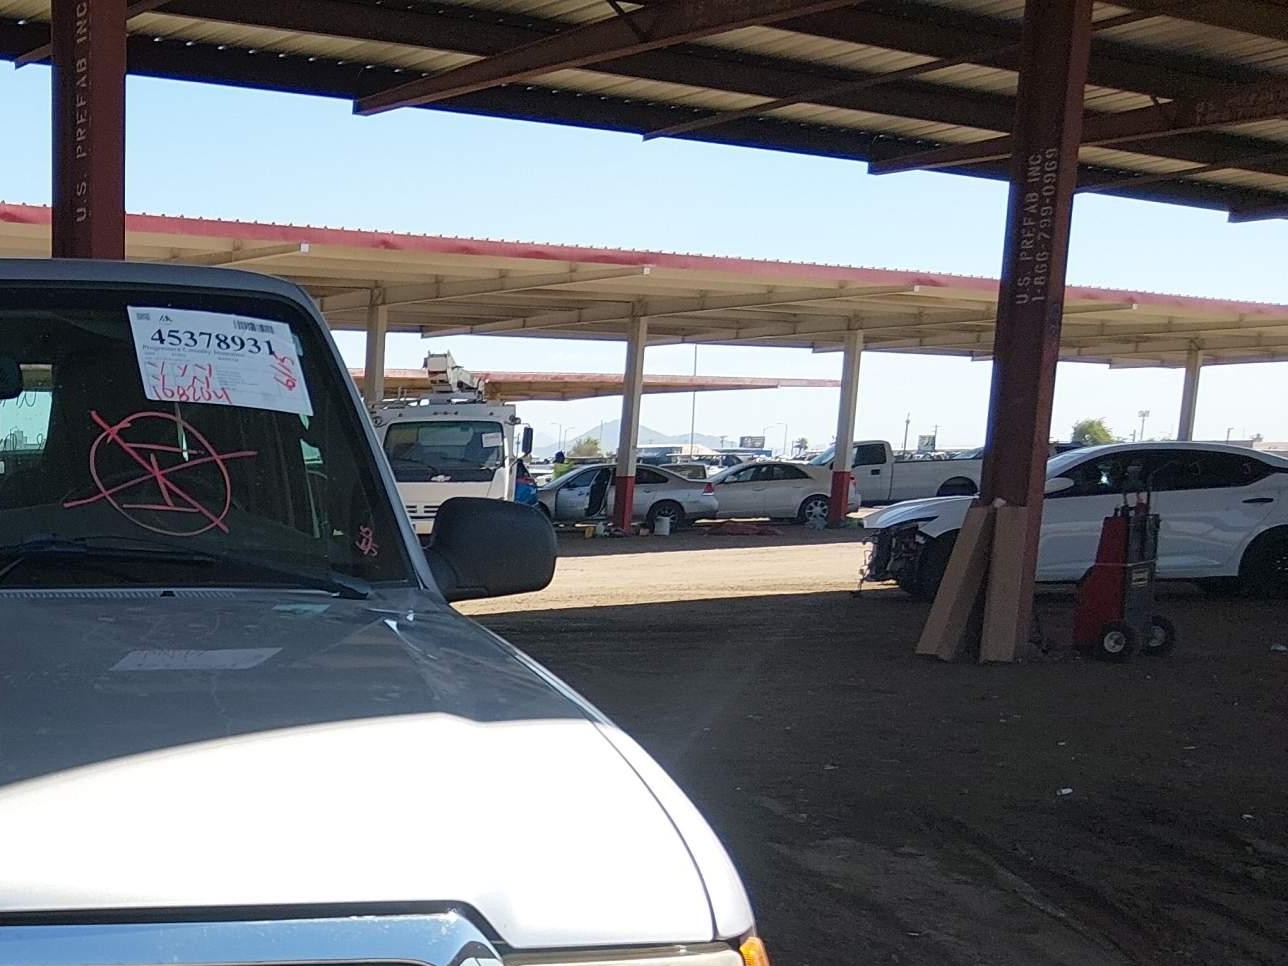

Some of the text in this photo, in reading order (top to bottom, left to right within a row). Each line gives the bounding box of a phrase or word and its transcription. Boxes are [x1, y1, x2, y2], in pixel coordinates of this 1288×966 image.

[75, 58, 88, 159] PREFAB
[75, 174, 88, 223] U.S.
[1018, 192, 1040, 261] PREFAB
[1015, 271, 1032, 305] U.S.
[150, 328, 274, 356] 45378931
